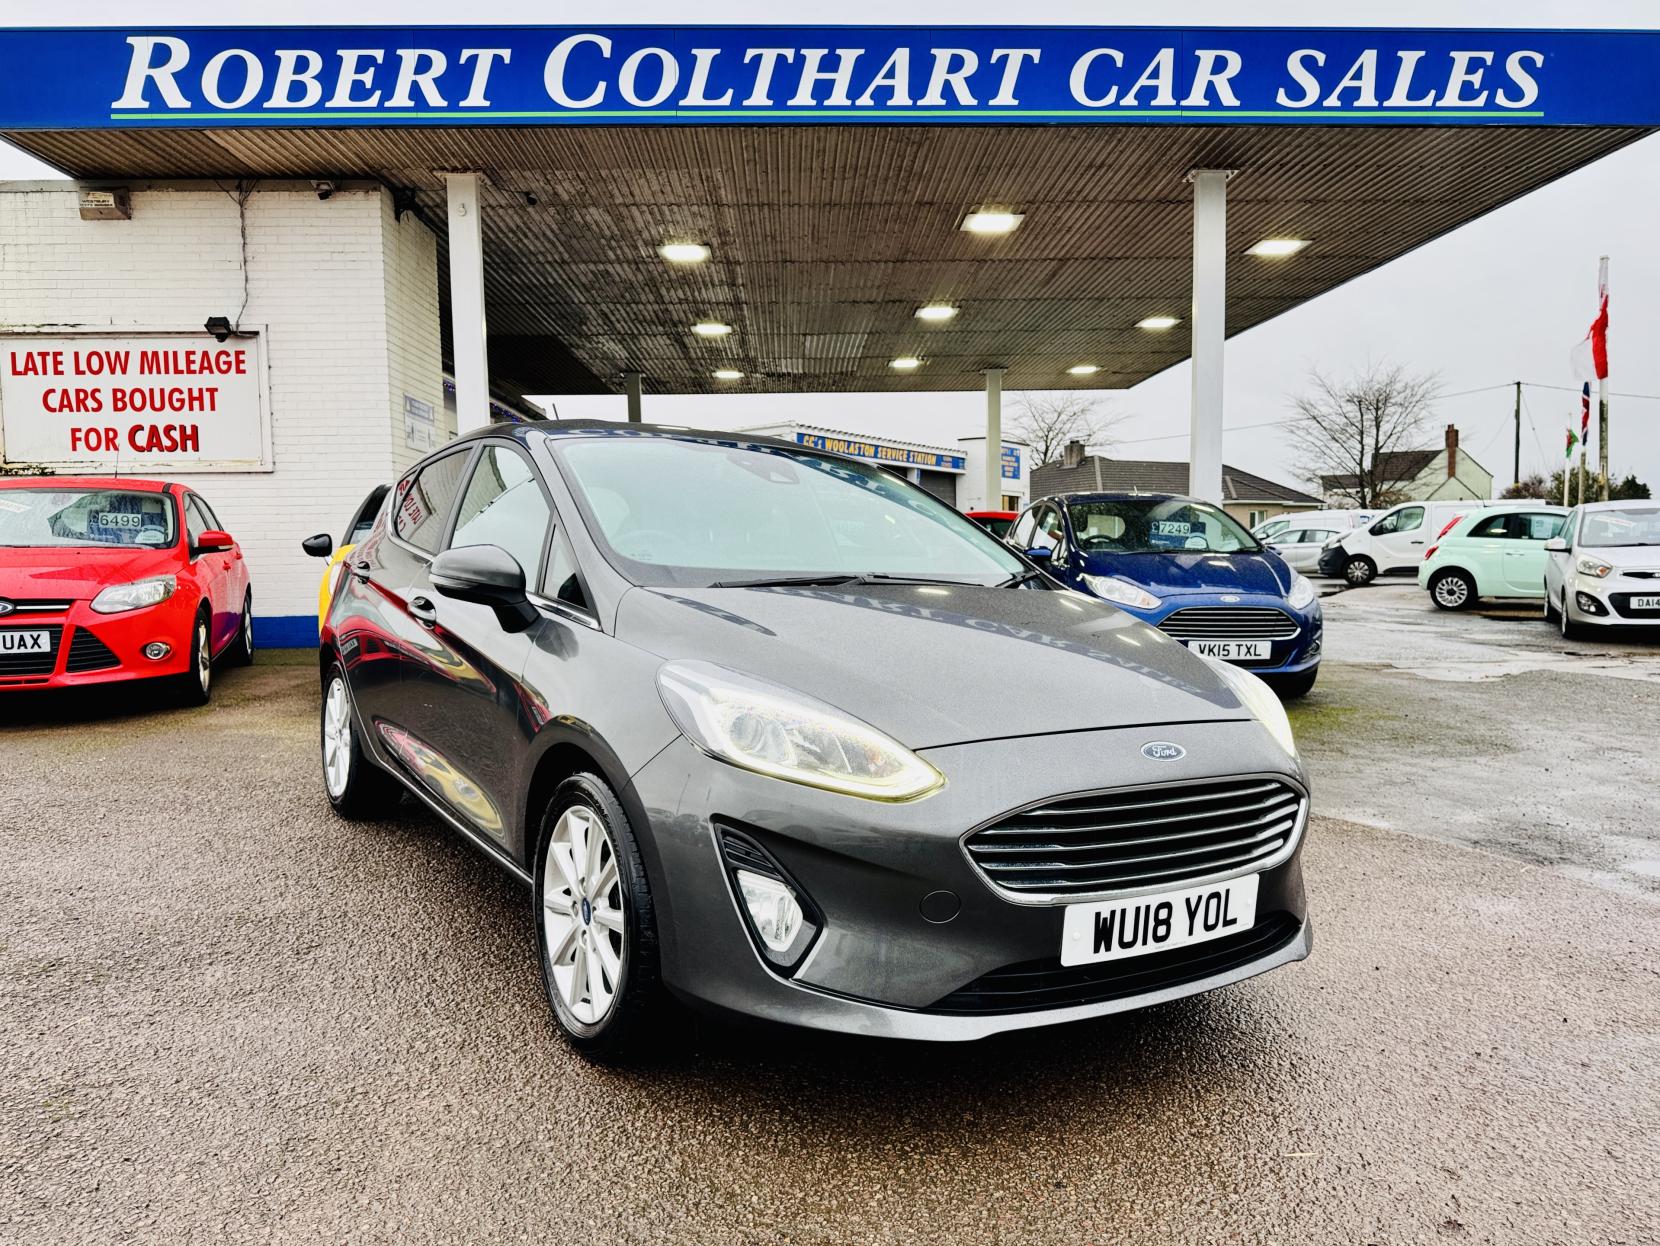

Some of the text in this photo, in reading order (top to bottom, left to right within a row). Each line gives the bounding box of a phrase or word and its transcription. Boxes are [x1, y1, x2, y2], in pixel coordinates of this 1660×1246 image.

[111, 33, 1545, 110] ROBERT COLTHART CAR SALES
[10, 350, 247, 377] LATE LOW MILEAGE
[41, 387, 219, 413] CARS BOUGHT
[70, 424, 200, 453] FOR CASH
[825, 437, 875, 458] WOOLASTON
[877, 446, 908, 463] SERVICE
[909, 451, 938, 466] STATION
[2, 633, 42, 650] UAX
[1198, 643, 1262, 657] VK15 TXL
[1152, 745, 1178, 758] Ford
[1093, 888, 1238, 954] WU18 YOL
